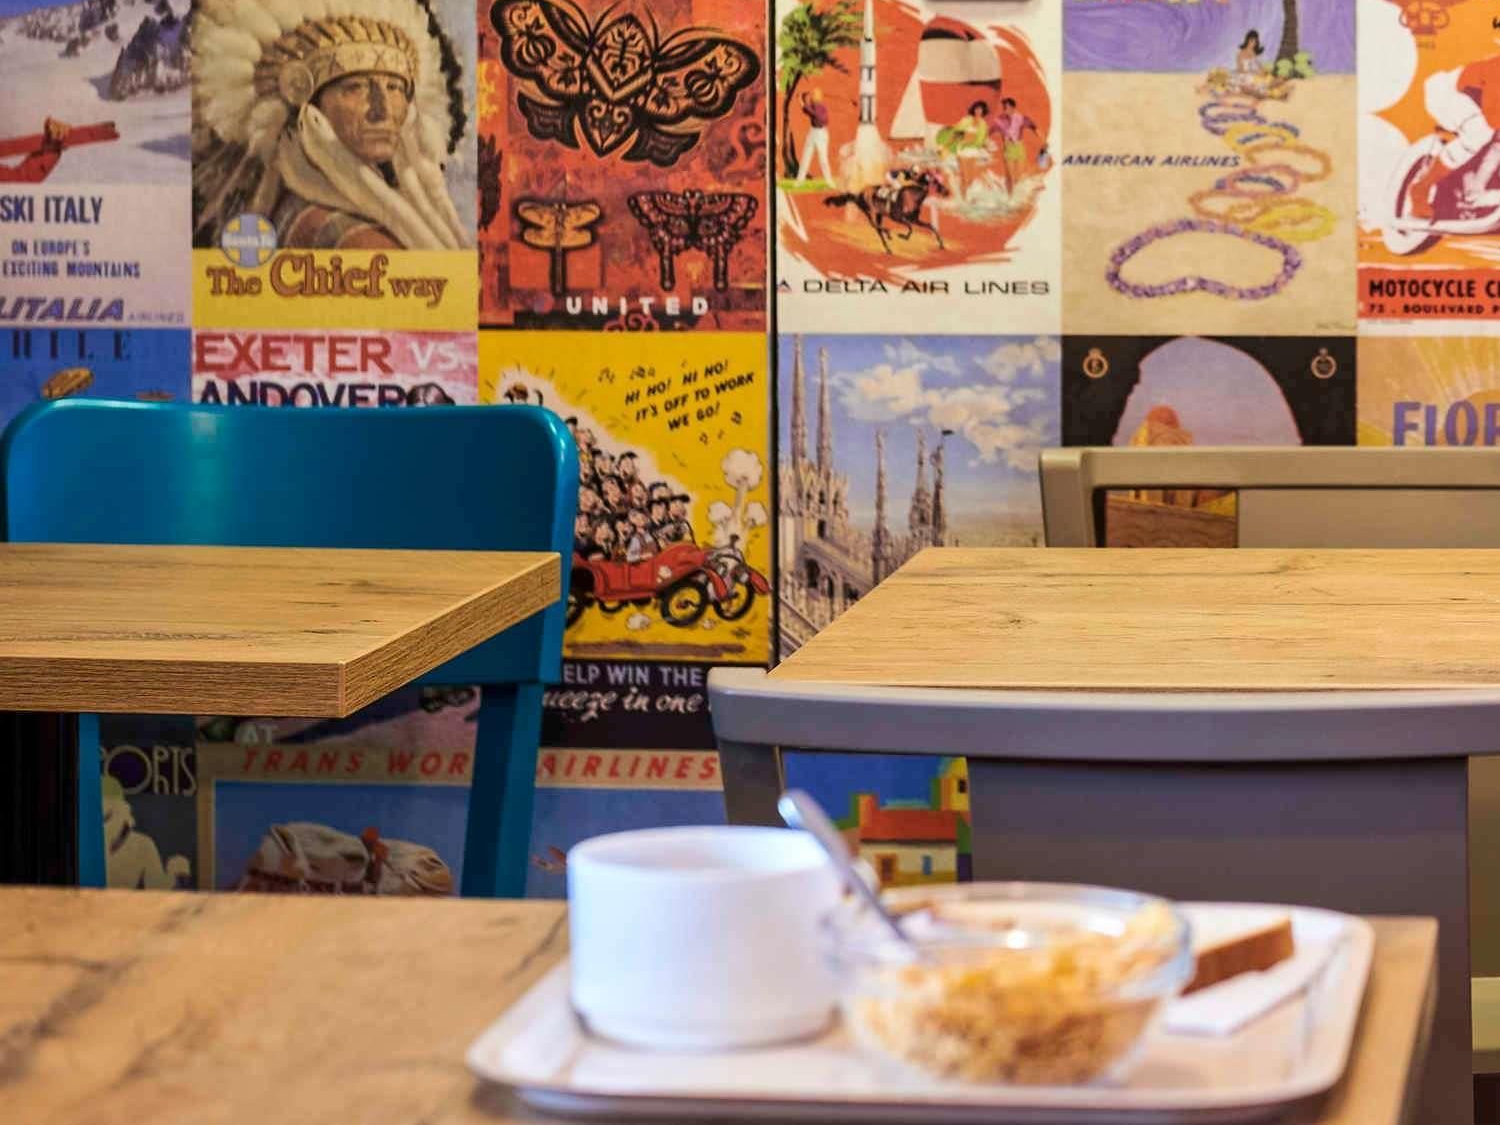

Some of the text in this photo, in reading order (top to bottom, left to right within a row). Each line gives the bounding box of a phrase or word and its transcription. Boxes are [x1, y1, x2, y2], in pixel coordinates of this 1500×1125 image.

[1063, 154, 1242, 167] AMERICAN AIRLINES
[0, 194, 103, 225] SKI ITALY
[66, 260, 142, 279] MOUNTAINS
[207, 252, 449, 309] The Chief way
[803, 279, 1051, 295] DELTA AIR LINES
[1369, 279, 1476, 299] MOTOCYCLE
[566, 295, 710, 316] UNITED
[194, 333, 394, 375] EXETER
[714, 371, 756, 396] WORK
[606, 664, 704, 687] WIN THE
[622, 686, 704, 714] in one
[242, 747, 365, 775] TRANS
[535, 752, 720, 780] AIRLINES
